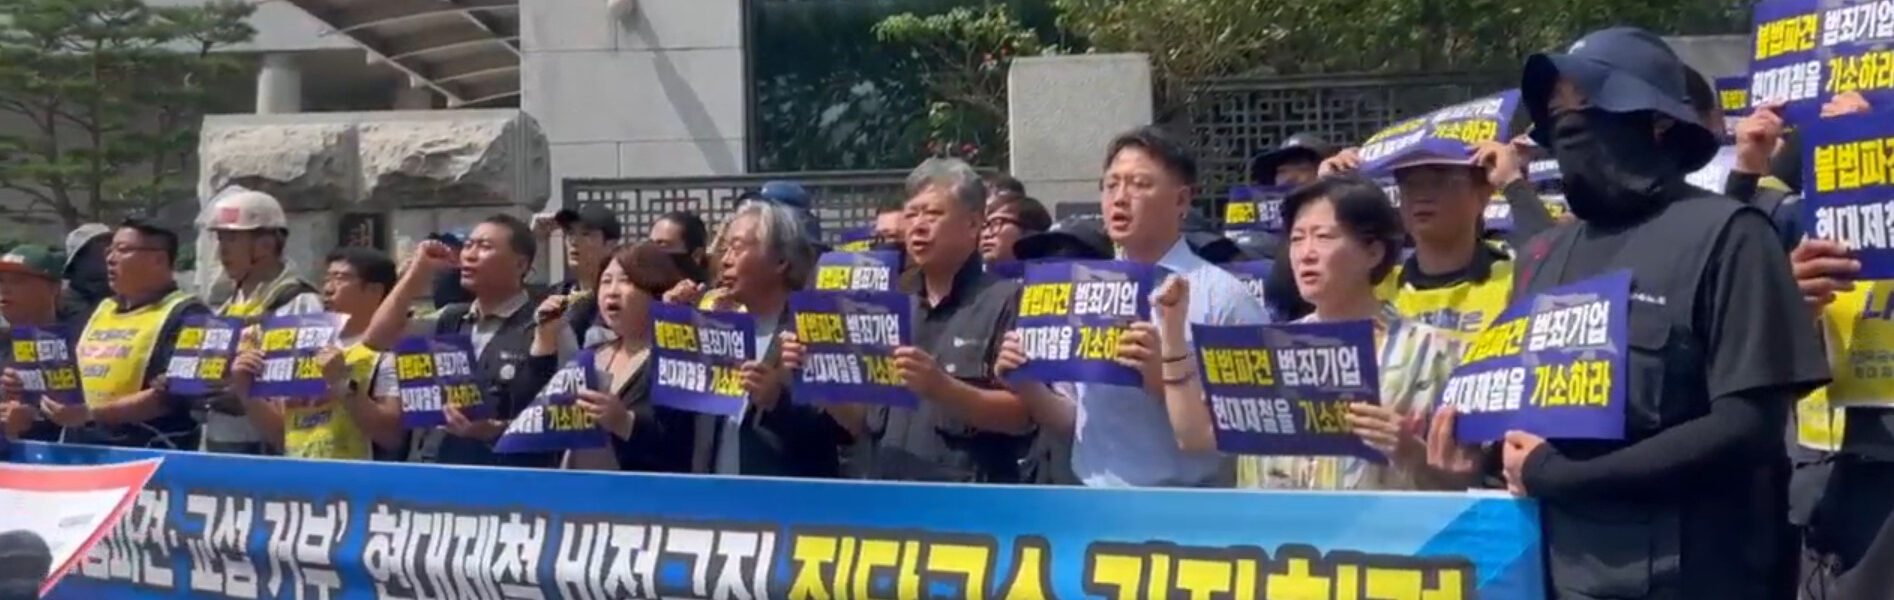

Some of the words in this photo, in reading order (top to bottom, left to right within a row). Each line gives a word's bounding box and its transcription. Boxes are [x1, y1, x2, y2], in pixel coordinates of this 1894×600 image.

[1755, 13, 1818, 60] 불법파견
[1823, 0, 1894, 46] 범죄기업
[1815, 136, 1894, 192] 불법파
[1074, 281, 1139, 316] 범죄기업
[698, 327, 745, 359] 범죄기업
[846, 313, 900, 346] 범죄기업
[1015, 326, 1073, 361] 대제철을
[1529, 300, 1611, 352] 범죄기업
[658, 357, 706, 392] 현대제철을
[1202, 347, 1275, 386] 불법파견
[1277, 346, 1361, 387] 범죄기업
[1529, 360, 1611, 407] 기소하라
[1211, 394, 1297, 434] 현대제철을
